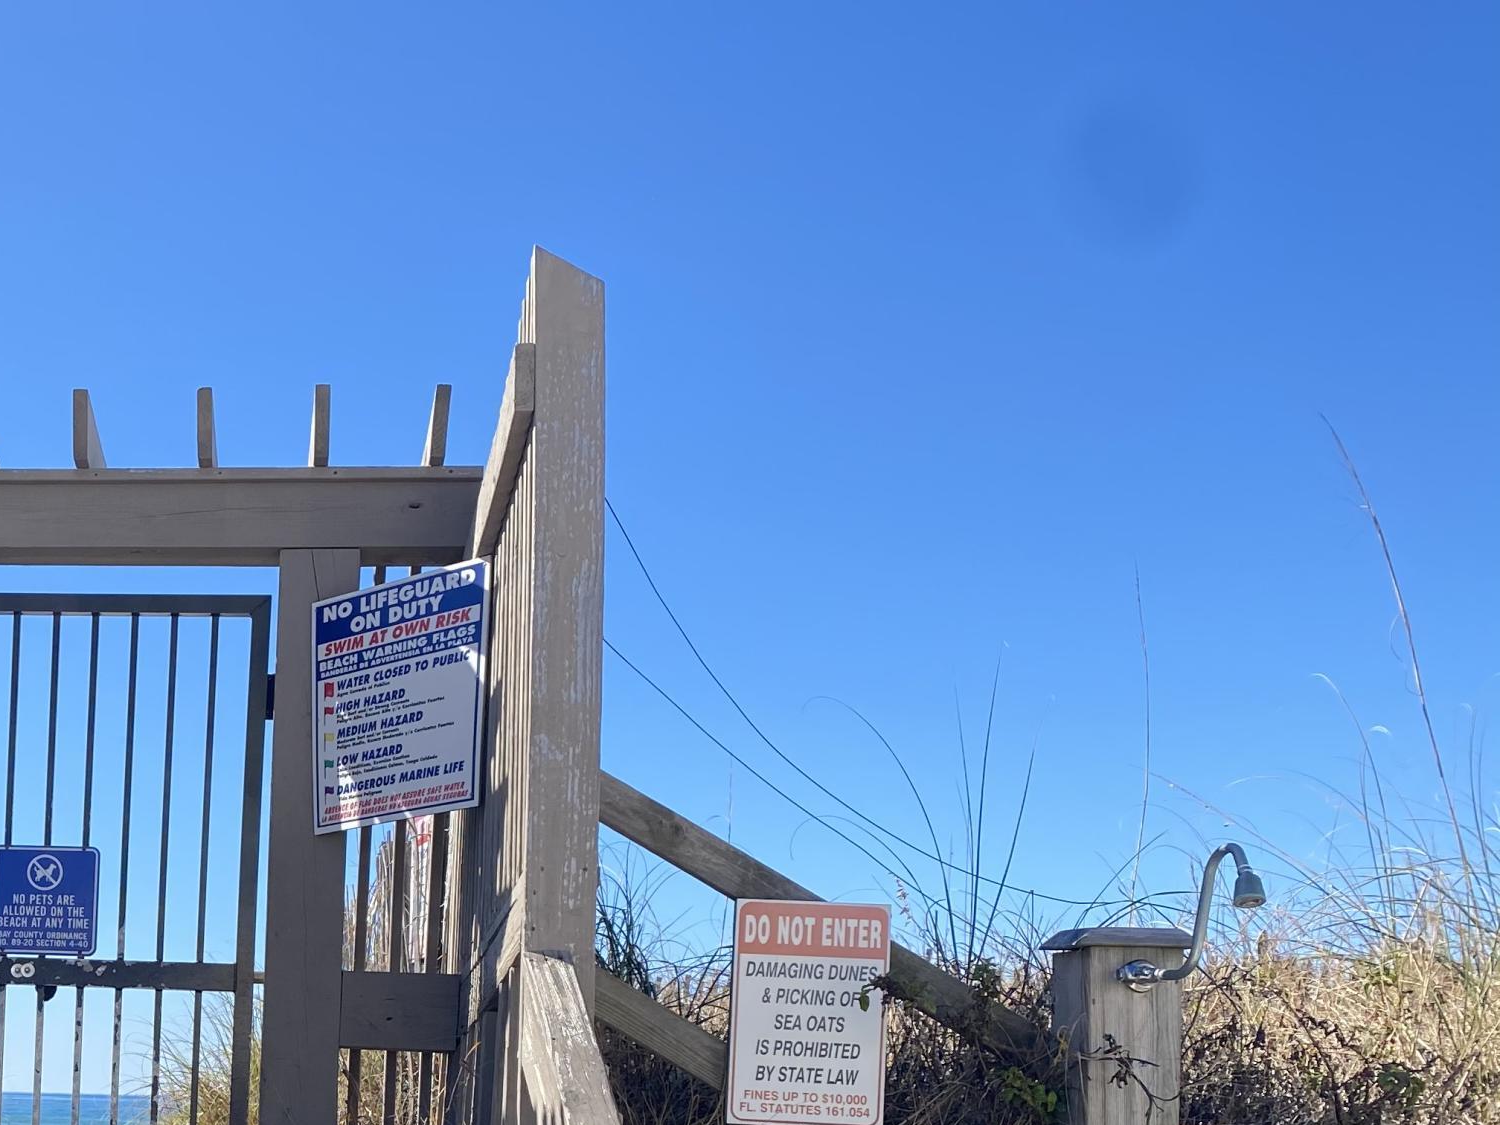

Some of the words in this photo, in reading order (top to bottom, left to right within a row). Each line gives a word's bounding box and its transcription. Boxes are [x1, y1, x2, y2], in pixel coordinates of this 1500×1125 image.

[323, 602, 352, 623] NO
[360, 569, 476, 612] LIFEGUARD
[351, 611, 380, 632] ON
[388, 594, 443, 623] DUTY
[325, 635, 364, 656] SWIM
[369, 629, 388, 646] AT
[392, 618, 430, 639] OWN
[436, 608, 472, 628] RISK
[319, 652, 358, 672] BEACH
[363, 637, 427, 660] WARNING
[433, 625, 475, 643] FLAGS
[320, 664, 357, 678] BANDERAS
[448, 637, 473, 648] PLAYA
[336, 674, 370, 691] WATER
[374, 664, 411, 681] CLOSED
[416, 658, 428, 671] TO
[433, 650, 470, 668] PUBLIC
[336, 698, 360, 714] HIGH
[364, 688, 406, 707] HAZARD
[337, 721, 376, 739] MEDIUM
[381, 711, 423, 729] HAZARD
[337, 752, 358, 767] LOW
[362, 744, 402, 761] HAZARD
[337, 774, 395, 796] DANGEROUS
[400, 766, 440, 782] MARINE
[443, 760, 465, 774] LIFE
[12, 894, 26, 904] NO
[29, 894, 53, 905] PETS
[57, 895, 75, 905] ARE
[3, 906, 47, 916] ALLOWED
[50, 907, 63, 917] ON
[68, 907, 85, 918] THE
[31, 918, 42, 928] AT
[45, 918, 64, 929] ANY
[68, 919, 89, 929] TIME
[744, 914, 771, 944] DO
[777, 916, 816, 946] NOT
[822, 918, 882, 948] ENTER
[11, 939, 33, 947] 89-20
[36, 939, 66, 947] SECTION
[68, 940, 89, 948] 4-40
[14, 931, 43, 939] COUNTY
[46, 931, 87, 940] ORDINANCE
[746, 961, 824, 980] DAMAGING
[828, 965, 878, 982] DUNES
[762, 987, 771, 1003] &
[776, 988, 835, 1007] PICKING
[840, 991, 861, 1007] OF
[774, 1014, 801, 1031] SEA
[806, 1016, 845, 1033] OATS
[756, 1039, 769, 1055] IS
[773, 1040, 861, 1059] PROHIBITED
[755, 1065, 775, 1081] BY
[778, 1066, 823, 1084] STATE
[827, 1069, 859, 1085] LAW
[744, 1090, 778, 1101] FINES
[783, 1091, 799, 1102] UP
[803, 1093, 817, 1102] TO
[822, 1093, 867, 1106] $10,000
[740, 1102, 755, 1112] FL.
[760, 1103, 821, 1115] STATUTES
[826, 1106, 870, 1118] 161.054
